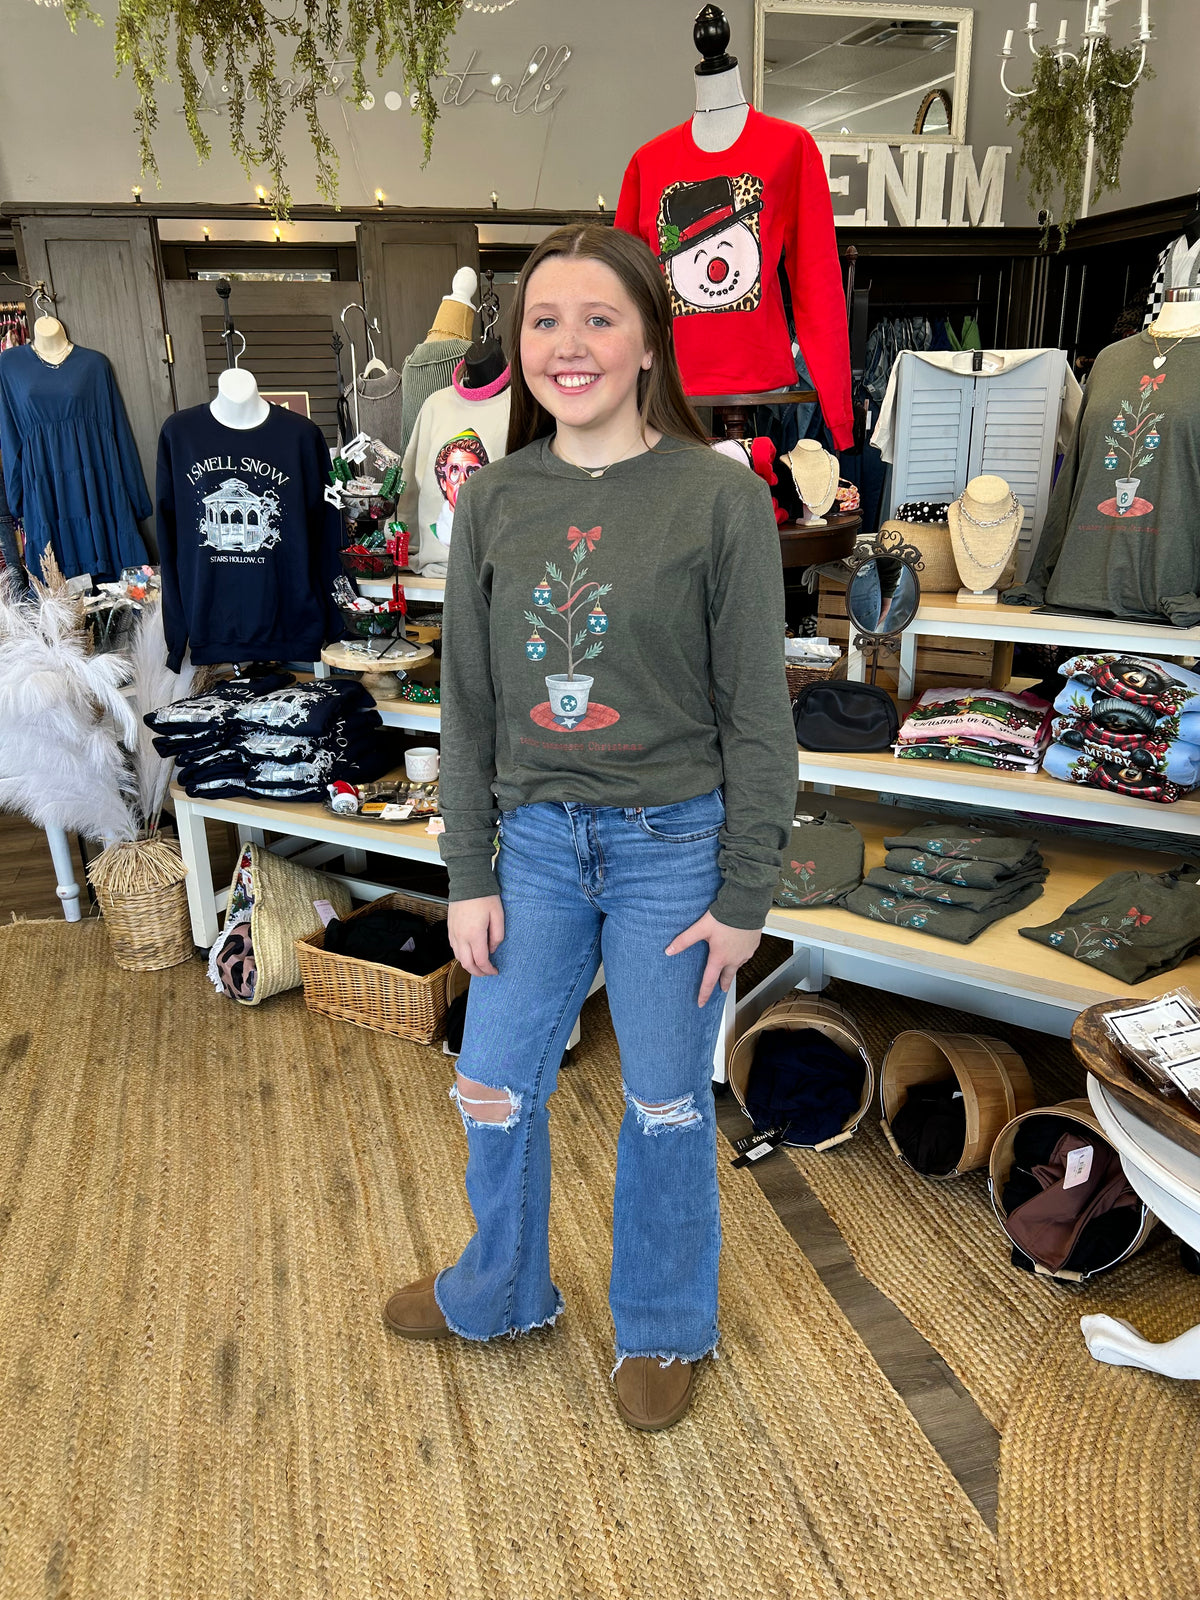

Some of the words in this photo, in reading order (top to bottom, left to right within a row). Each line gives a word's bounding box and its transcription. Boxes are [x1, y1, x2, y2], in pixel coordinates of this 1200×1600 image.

[436, 50, 489, 106] it
[495, 44, 572, 114] all
[813, 141, 1012, 227] ENIM
[186, 473, 195, 485] I
[191, 456, 237, 481] SMELL
[240, 457, 290, 485] SNOW
[1083, 744, 1133, 768] MERRY
